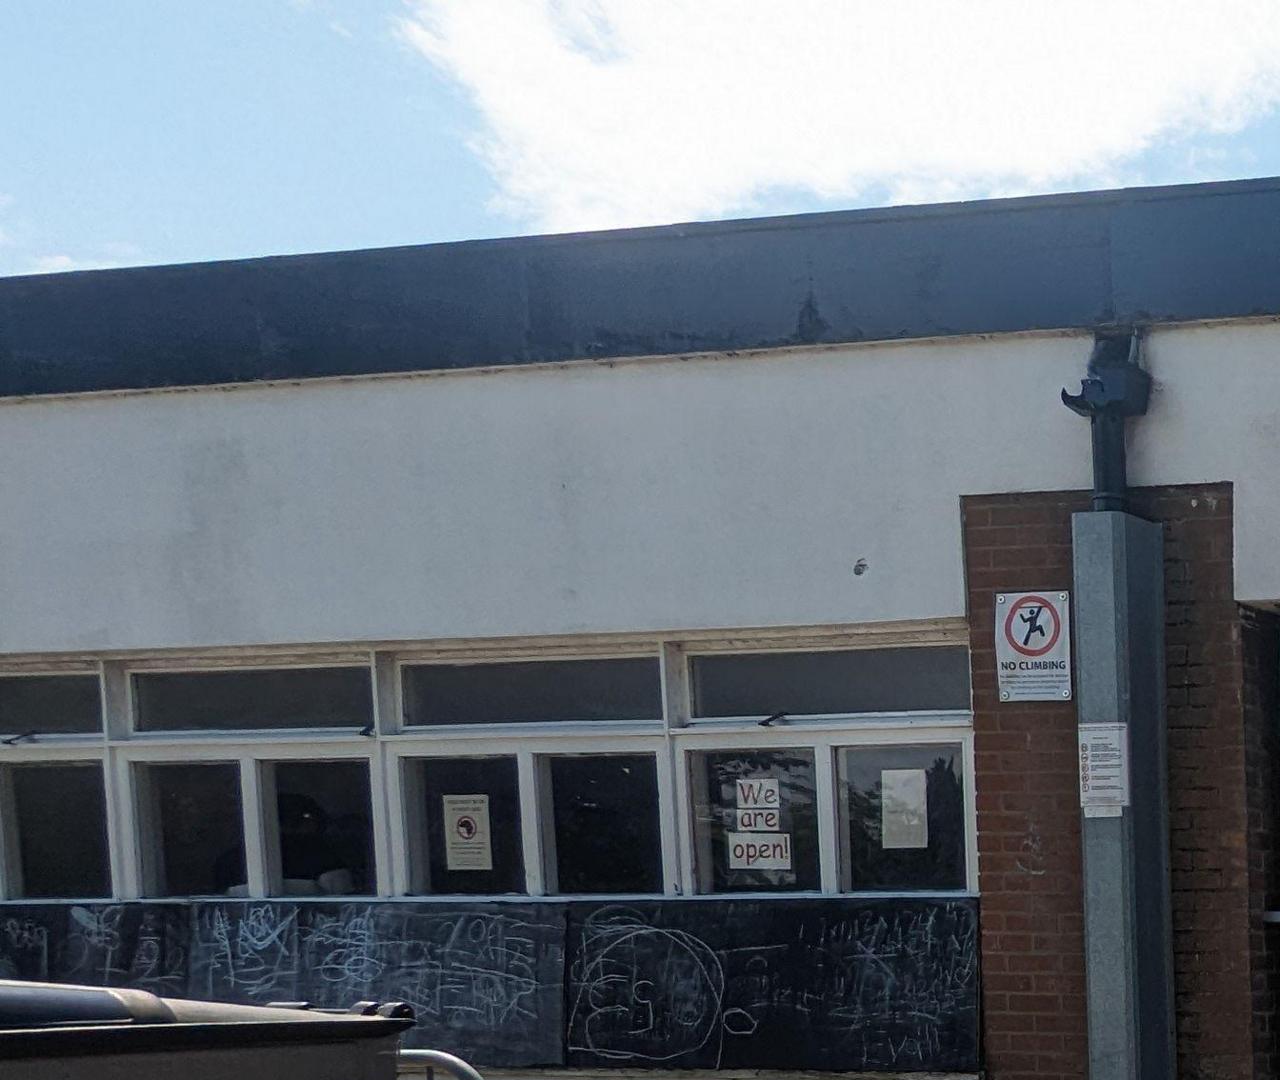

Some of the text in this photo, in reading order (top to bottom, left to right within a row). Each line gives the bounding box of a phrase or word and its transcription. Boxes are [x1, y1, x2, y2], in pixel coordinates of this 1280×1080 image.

[1001, 660, 1066, 671] NO CLIMBING
[739, 782, 776, 805] We
[740, 812, 777, 827] are
[733, 836, 790, 866] open!
